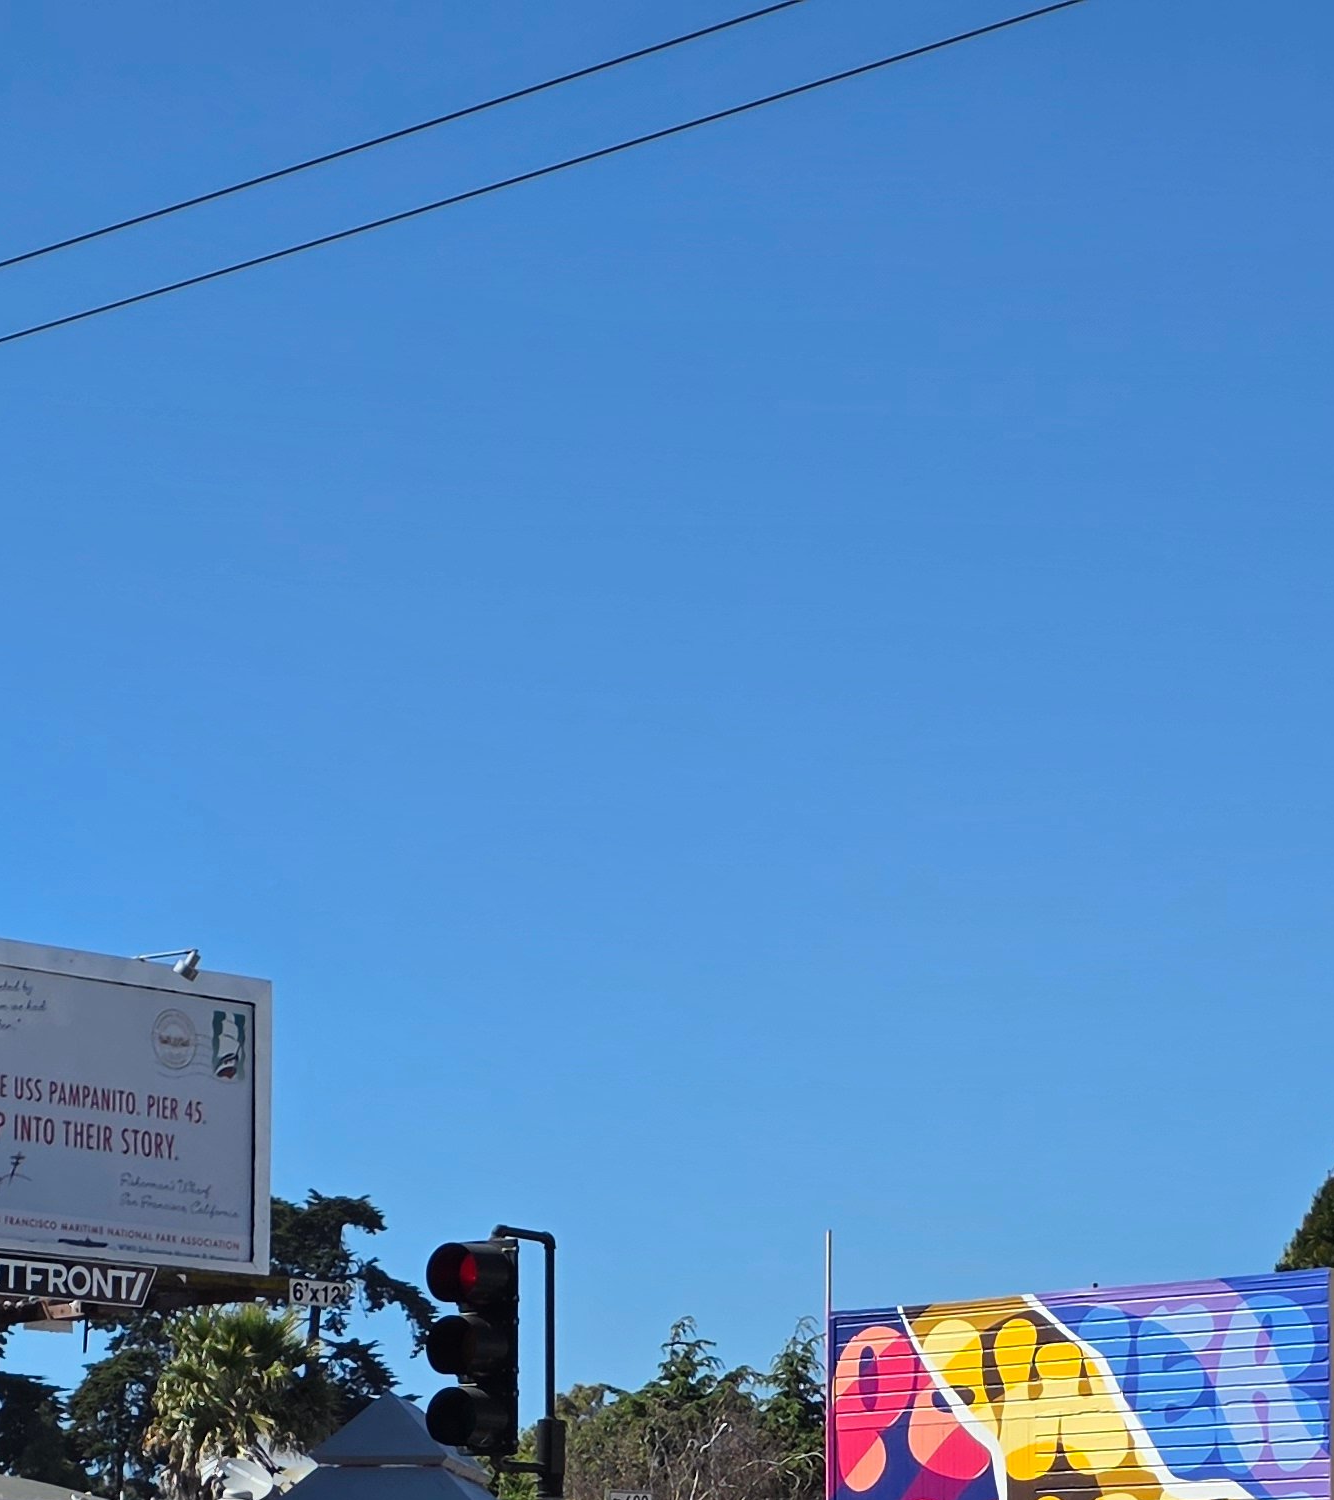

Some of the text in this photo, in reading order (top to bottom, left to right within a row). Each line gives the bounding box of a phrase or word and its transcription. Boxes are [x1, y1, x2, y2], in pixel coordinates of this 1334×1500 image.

[13, 1075, 43, 1103] USS
[48, 1080, 142, 1117] PAMPANITO.
[146, 1094, 179, 1121] PIER
[183, 1100, 208, 1126] 45.
[13, 1113, 56, 1146] INTO
[62, 1119, 114, 1153] THEIR
[120, 1127, 180, 1162] STORY.
[3, 1214, 58, 1231] FRANCISCO
[60, 1221, 105, 1236] MARITIME
[107, 1226, 155, 1242] NATIONAL
[155, 1232, 178, 1245] PARK
[180, 1234, 241, 1252] ASSOCIATION
